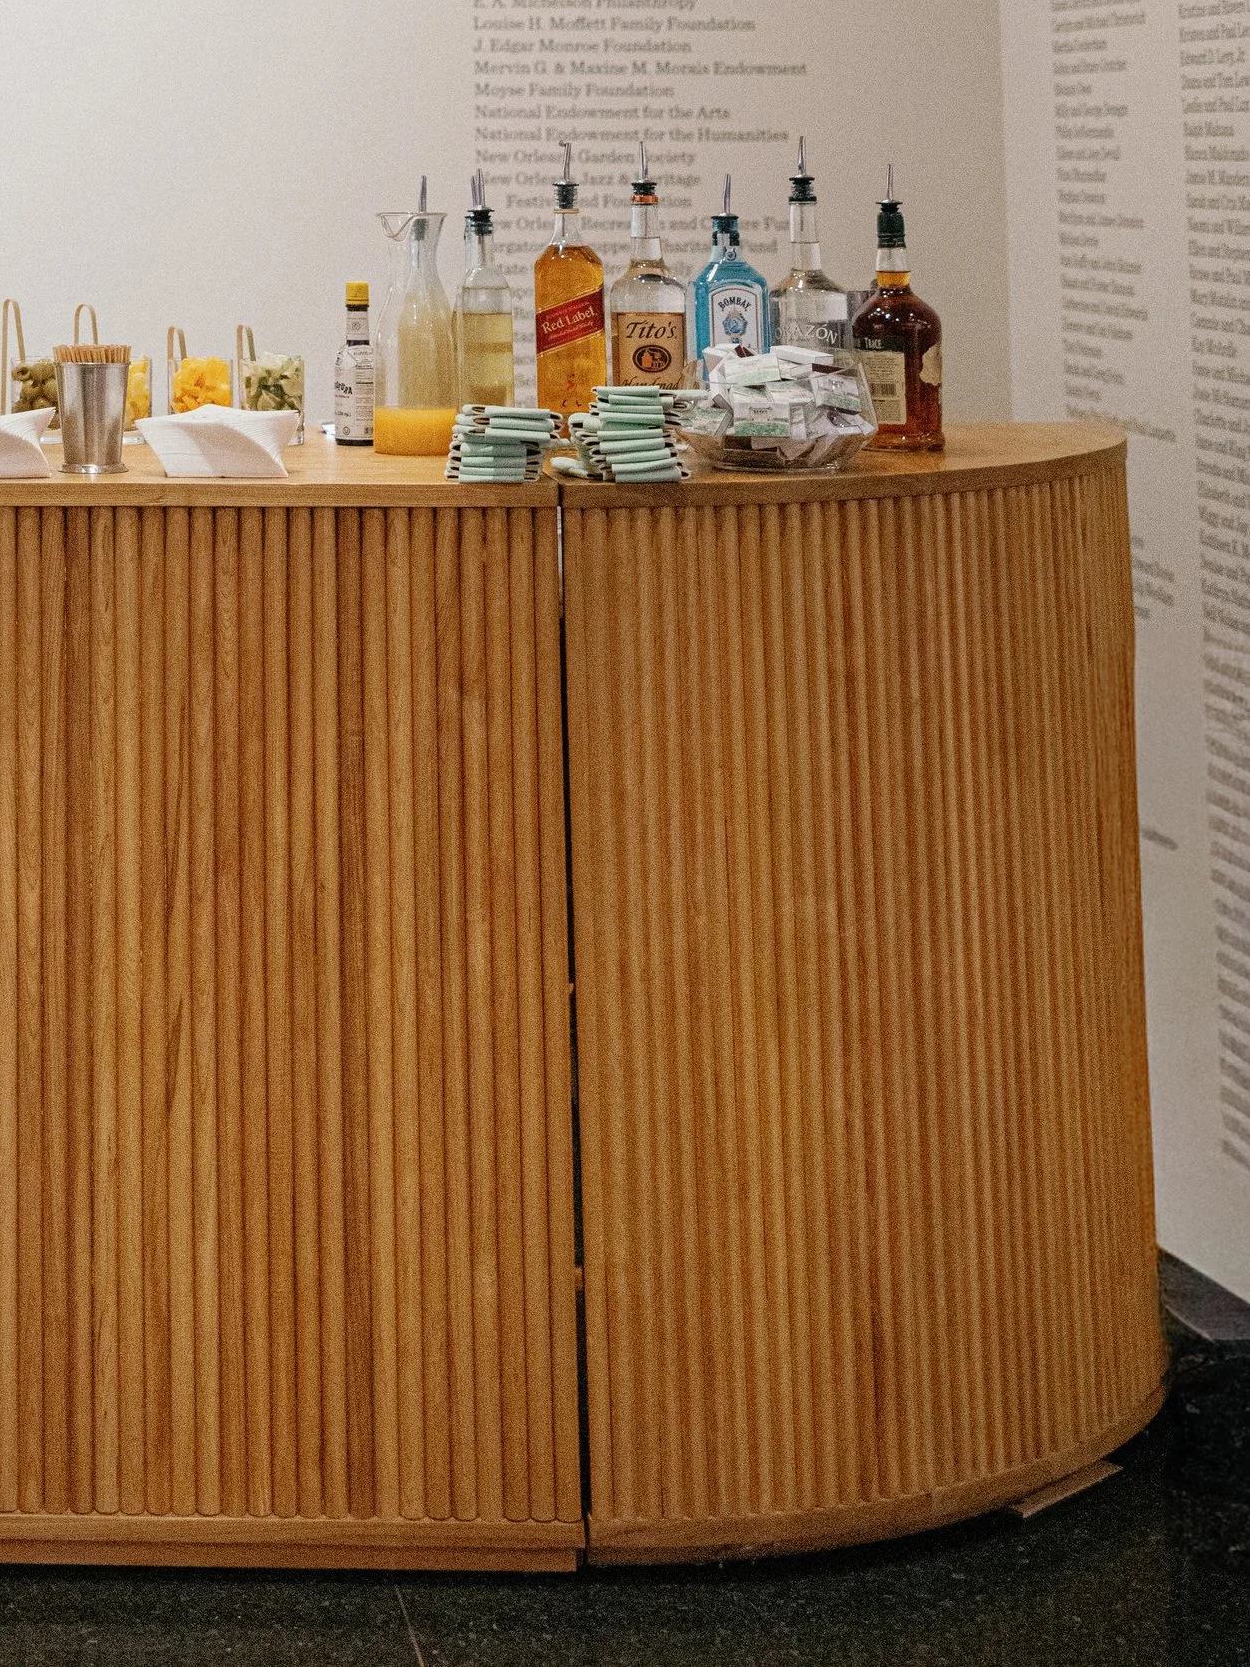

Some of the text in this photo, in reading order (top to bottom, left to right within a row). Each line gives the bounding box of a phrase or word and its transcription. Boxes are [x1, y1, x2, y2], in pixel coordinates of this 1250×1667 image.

[717, 296, 752, 312] BOMBAY
[541, 317, 565, 334] Red
[565, 306, 596, 325] Label
[625, 320, 678, 339] Tito's
[773, 322, 838, 344] ORAZÓN
[864, 337, 882, 349] TRACE
